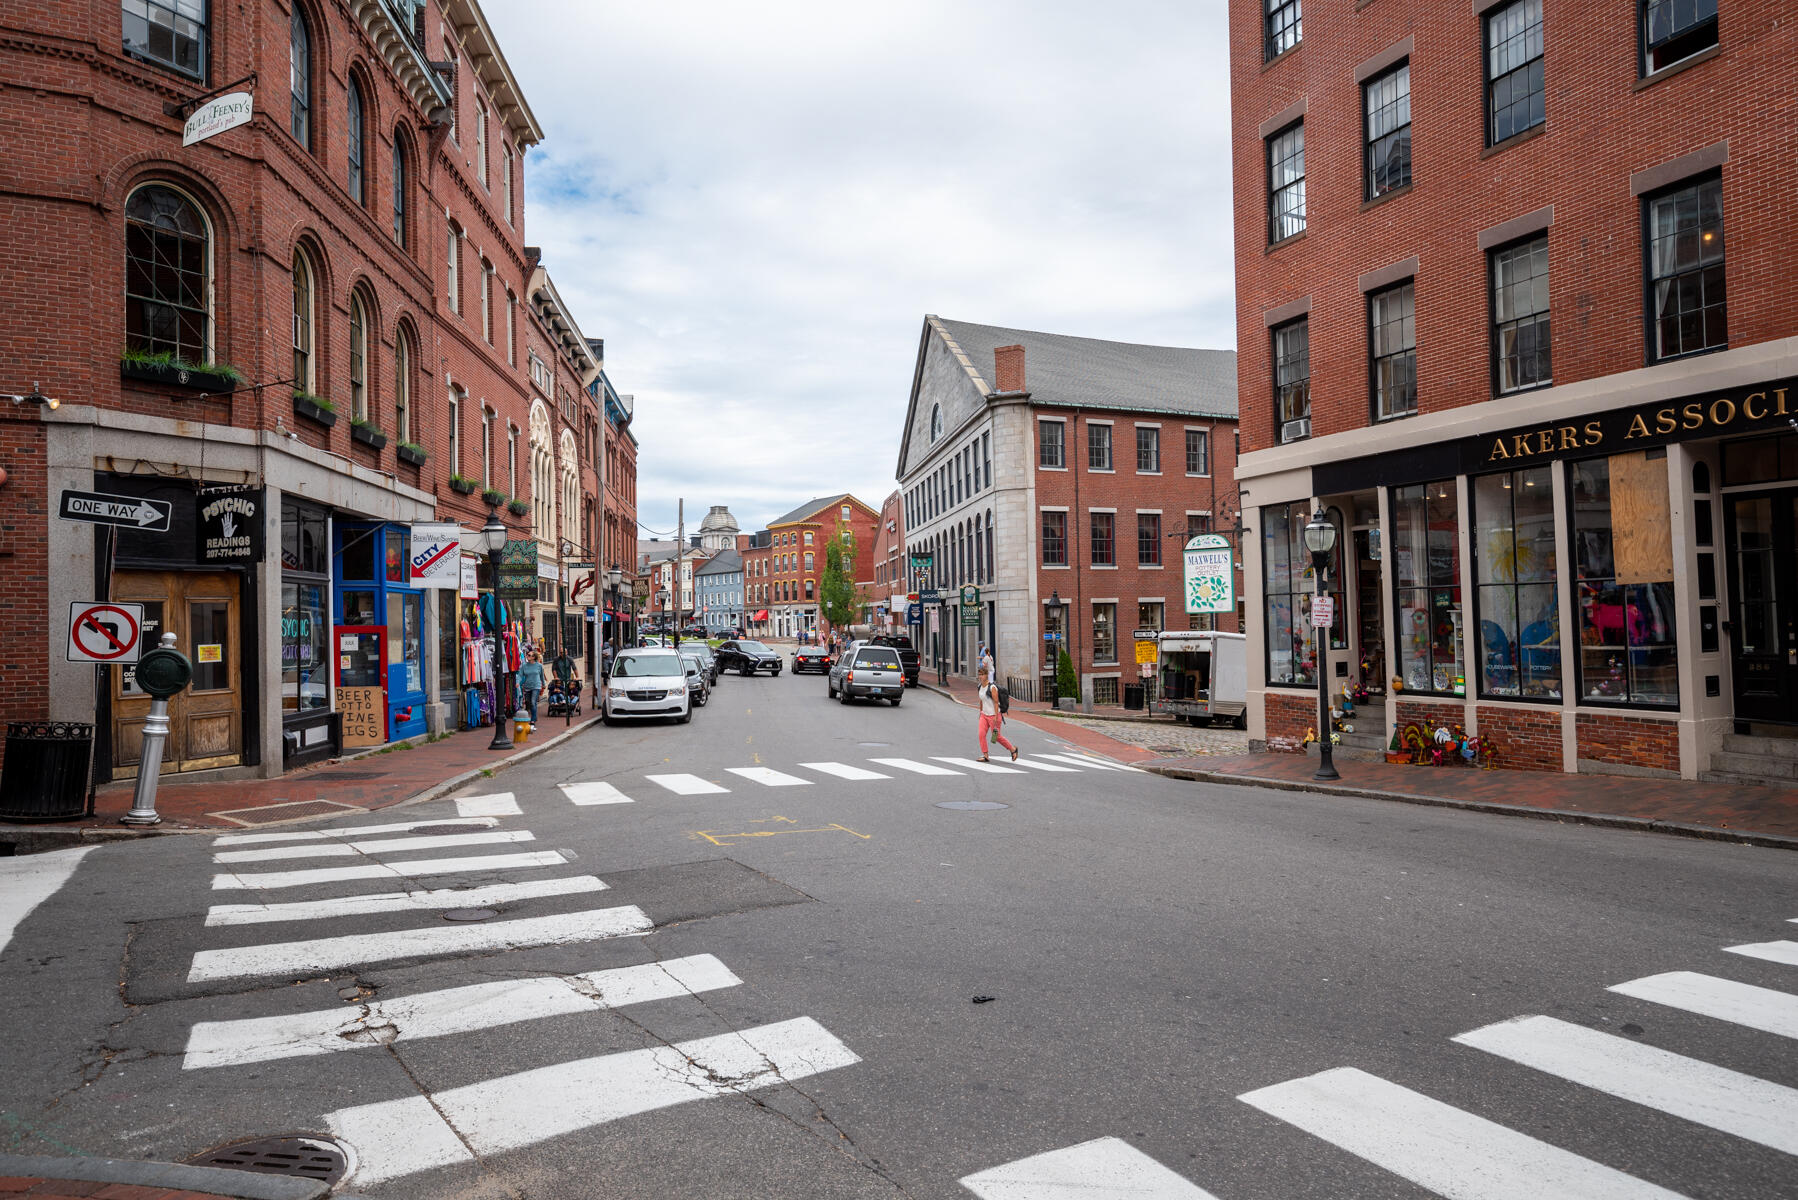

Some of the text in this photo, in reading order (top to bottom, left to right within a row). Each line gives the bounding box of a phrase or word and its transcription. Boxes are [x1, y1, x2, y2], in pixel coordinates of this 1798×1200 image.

[186, 100, 250, 138] BULL FEENEY'S
[224, 114, 236, 129] pub
[1489, 387, 1798, 462] AKERS ASSOCI
[72, 500, 138, 518] ONE WAY
[202, 497, 255, 523] PSYCHIC
[206, 535, 251, 549] READINGS
[413, 543, 440, 566] CITY
[423, 548, 460, 578] BEVERAGE
[1188, 554, 1228, 566] MAXWELL'S
[281, 617, 309, 638] SYCIC
[336, 688, 371, 701] BEER
[342, 725, 378, 738] IGS
